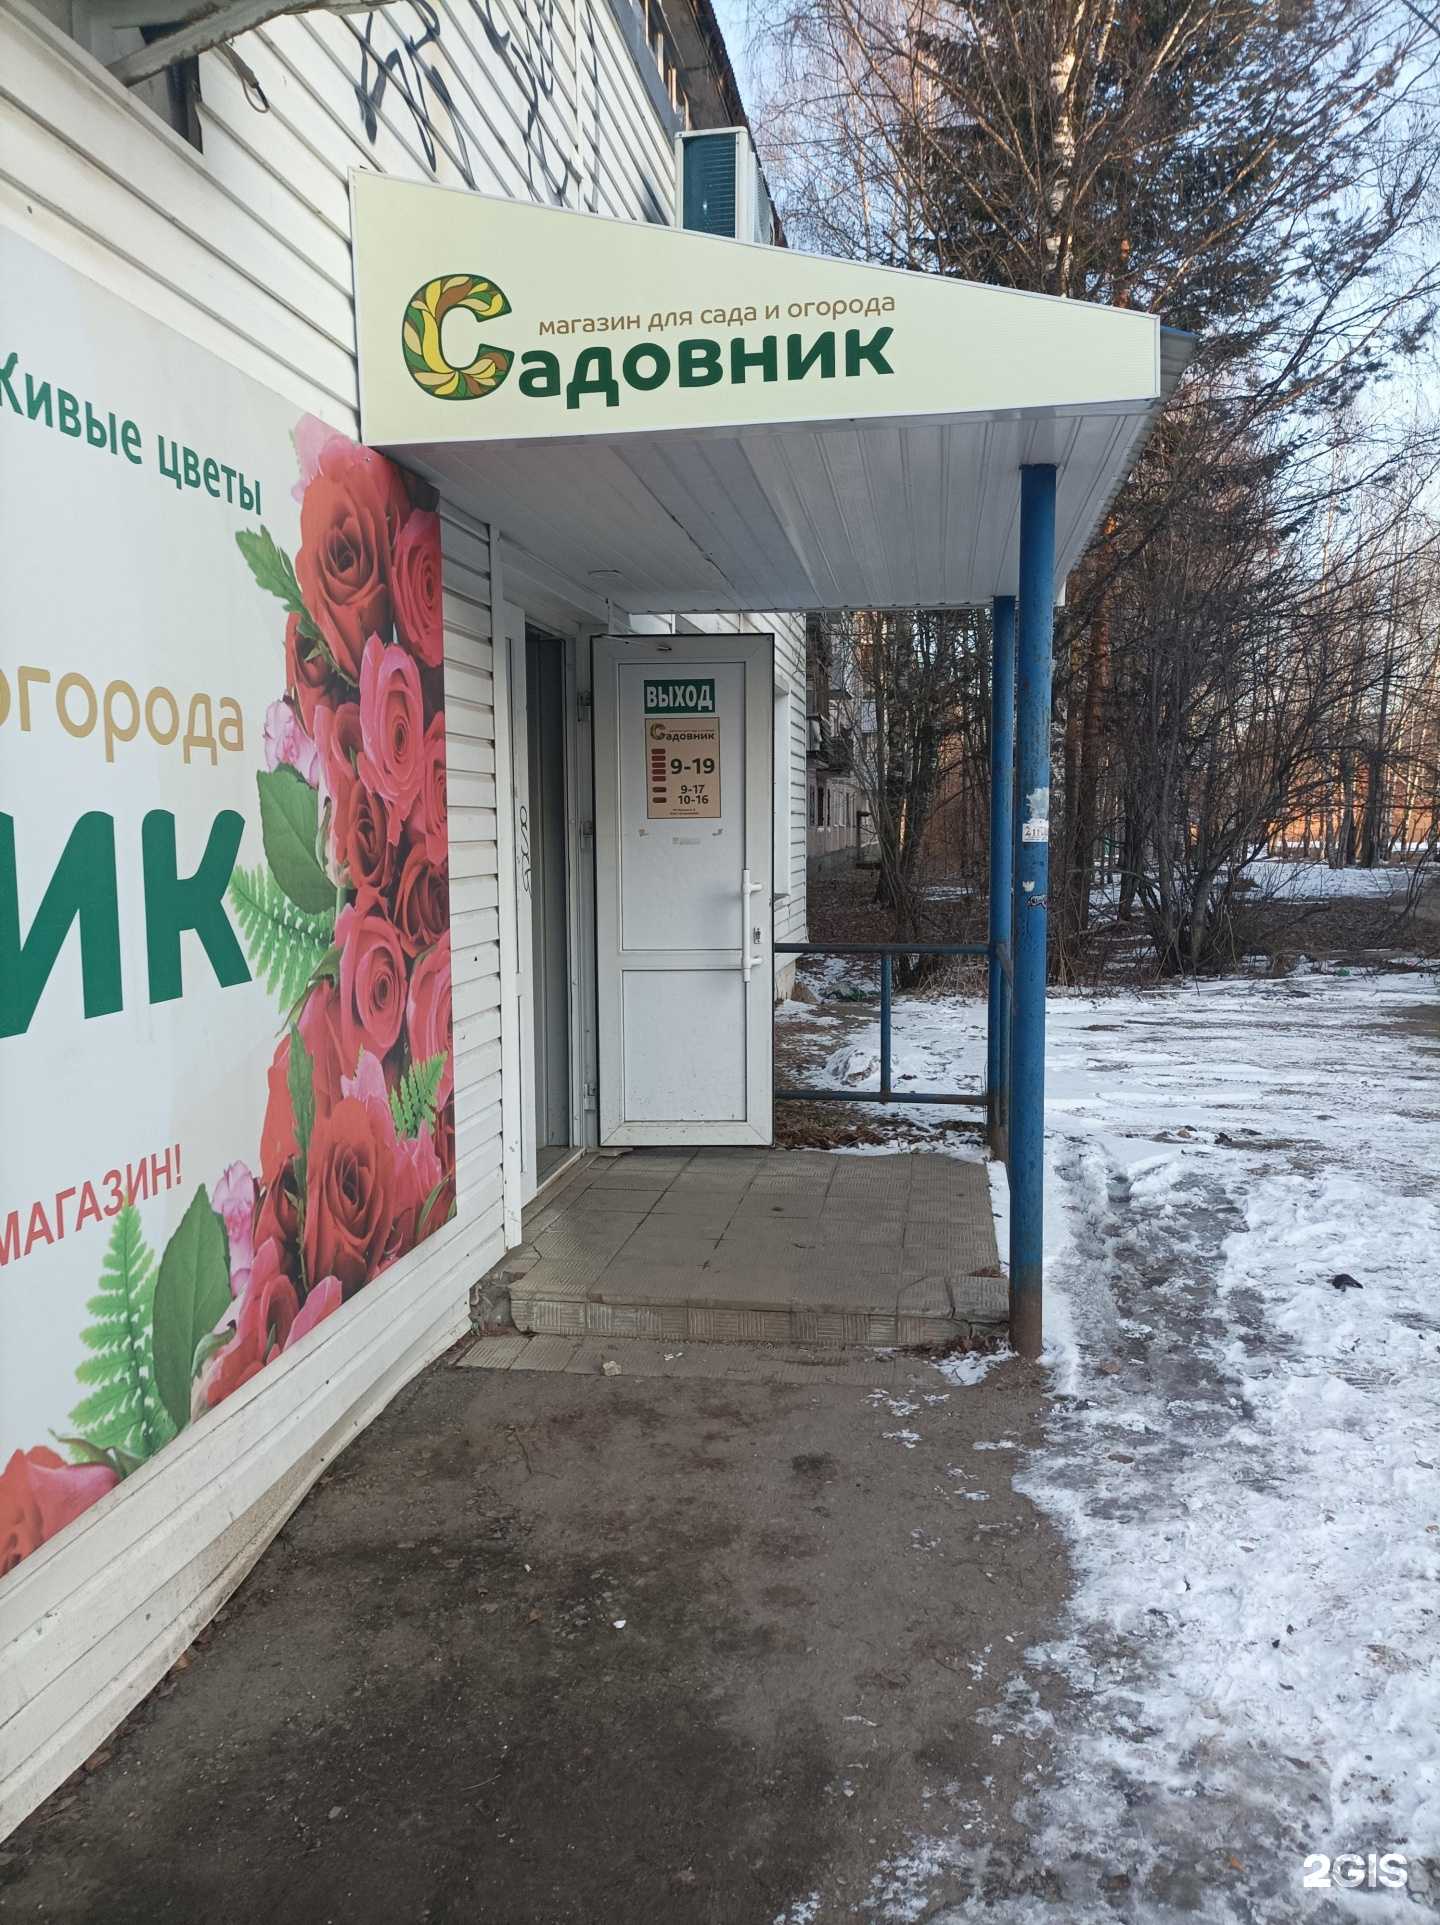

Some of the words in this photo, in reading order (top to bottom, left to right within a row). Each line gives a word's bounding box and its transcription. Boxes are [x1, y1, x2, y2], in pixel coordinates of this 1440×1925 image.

[539, 314, 641, 336] магазин
[648, 310, 693, 333] для
[700, 305, 758, 327] сада
[765, 303, 780, 319] и
[787, 295, 895, 320] огорода
[402, 273, 895, 410] Садовник
[157, 434, 262, 516] цветы
[646, 685, 713, 711] ВЫХОД
[0, 666, 245, 766] города
[670, 758, 715, 775] 9-19
[677, 794, 709, 805] 10-16
[680, 784, 705, 794] 9-17
